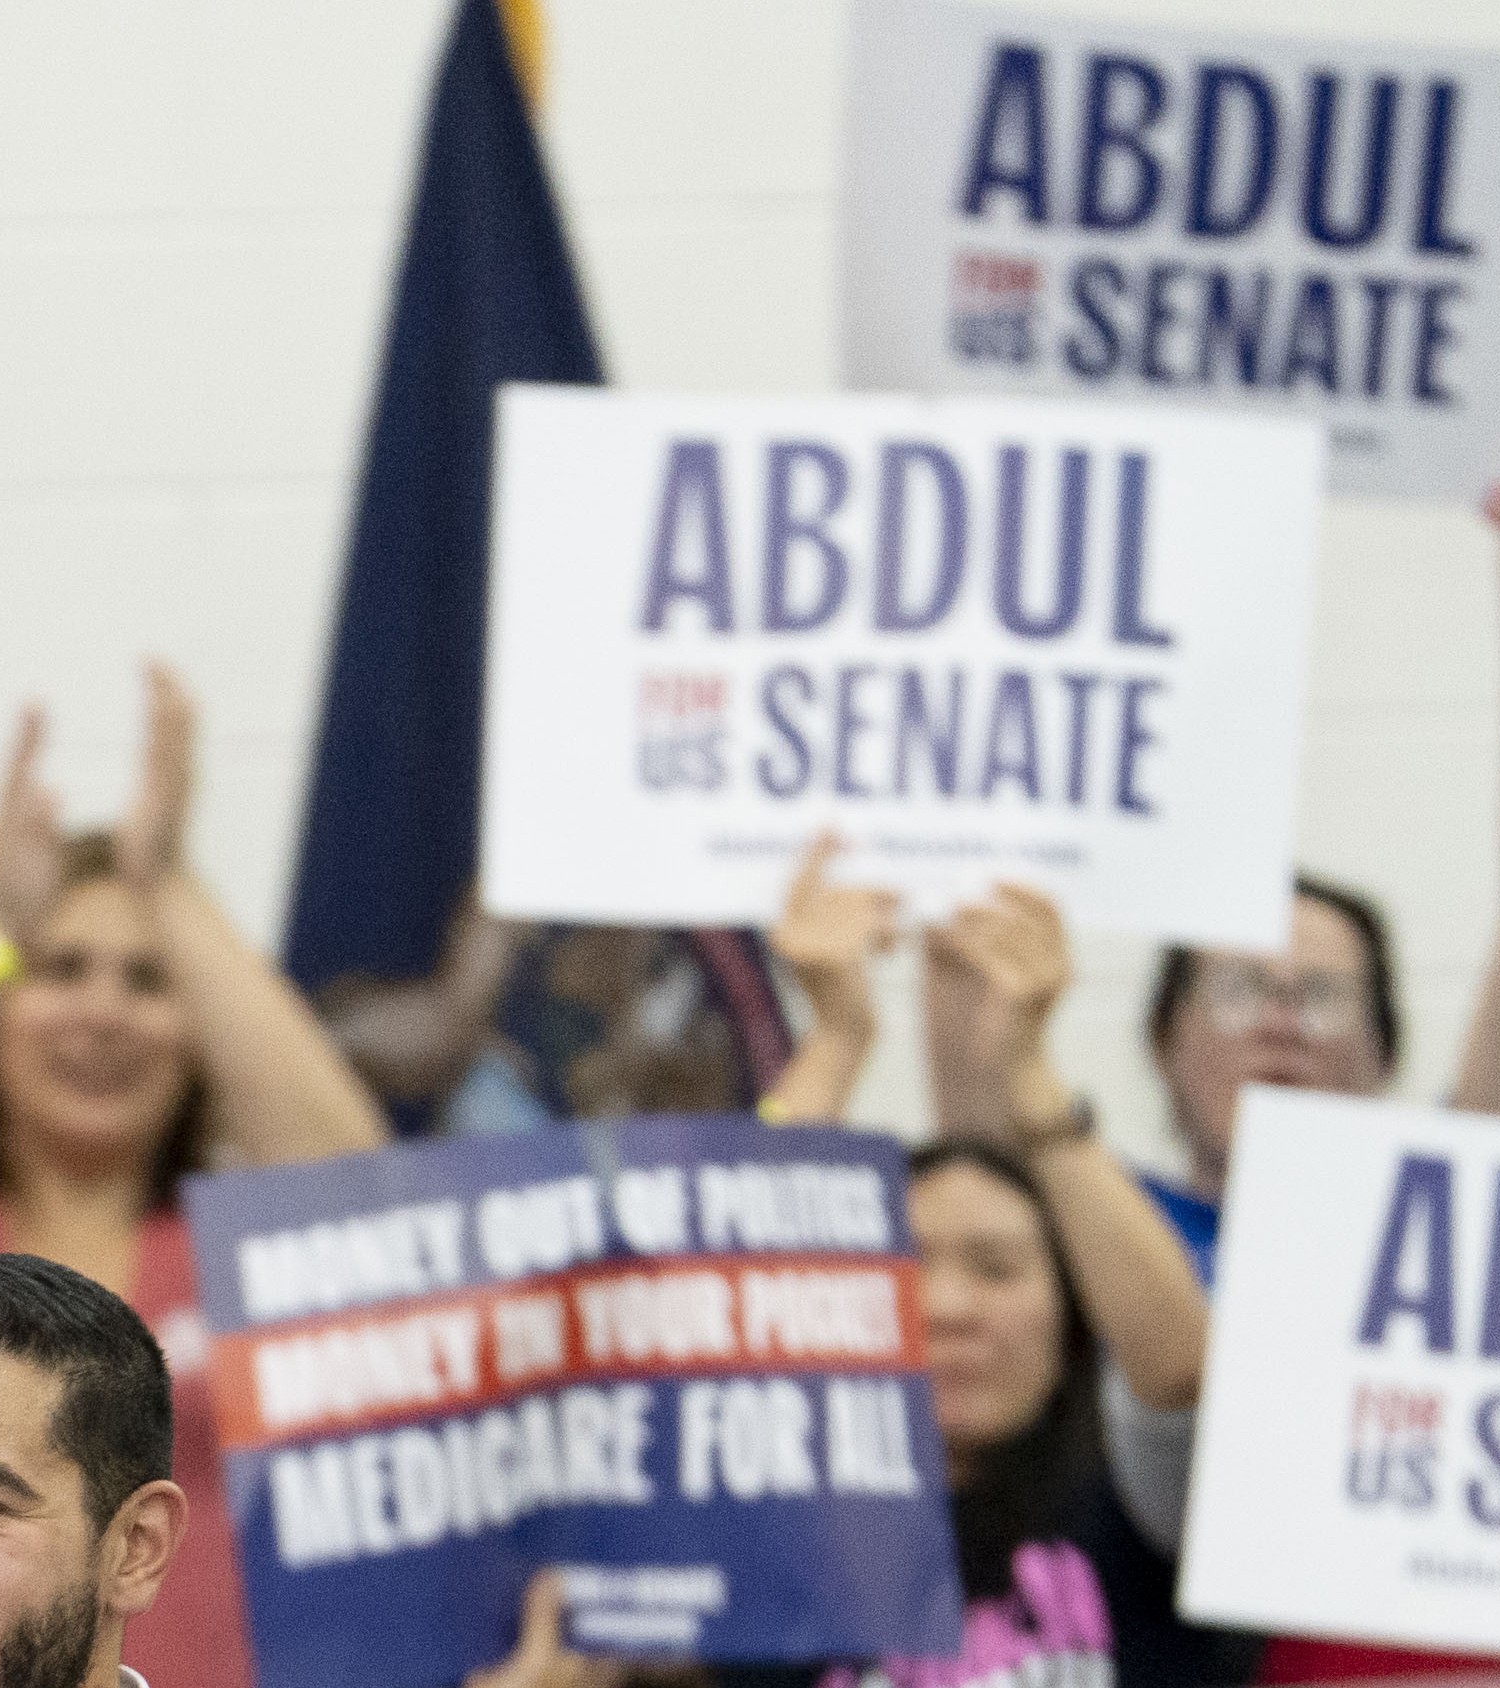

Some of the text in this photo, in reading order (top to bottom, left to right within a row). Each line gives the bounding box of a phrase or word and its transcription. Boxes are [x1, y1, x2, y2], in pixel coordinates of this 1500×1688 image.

[958, 39, 1482, 262] ABDUL
[1064, 253, 1468, 406] SENATE
[638, 436, 1178, 649] ABDUL
[754, 663, 1171, 818] SENATE
[270, 1377, 922, 1571] MEDICARE FOR ALL
[1344, 1442, 1438, 1511] US
